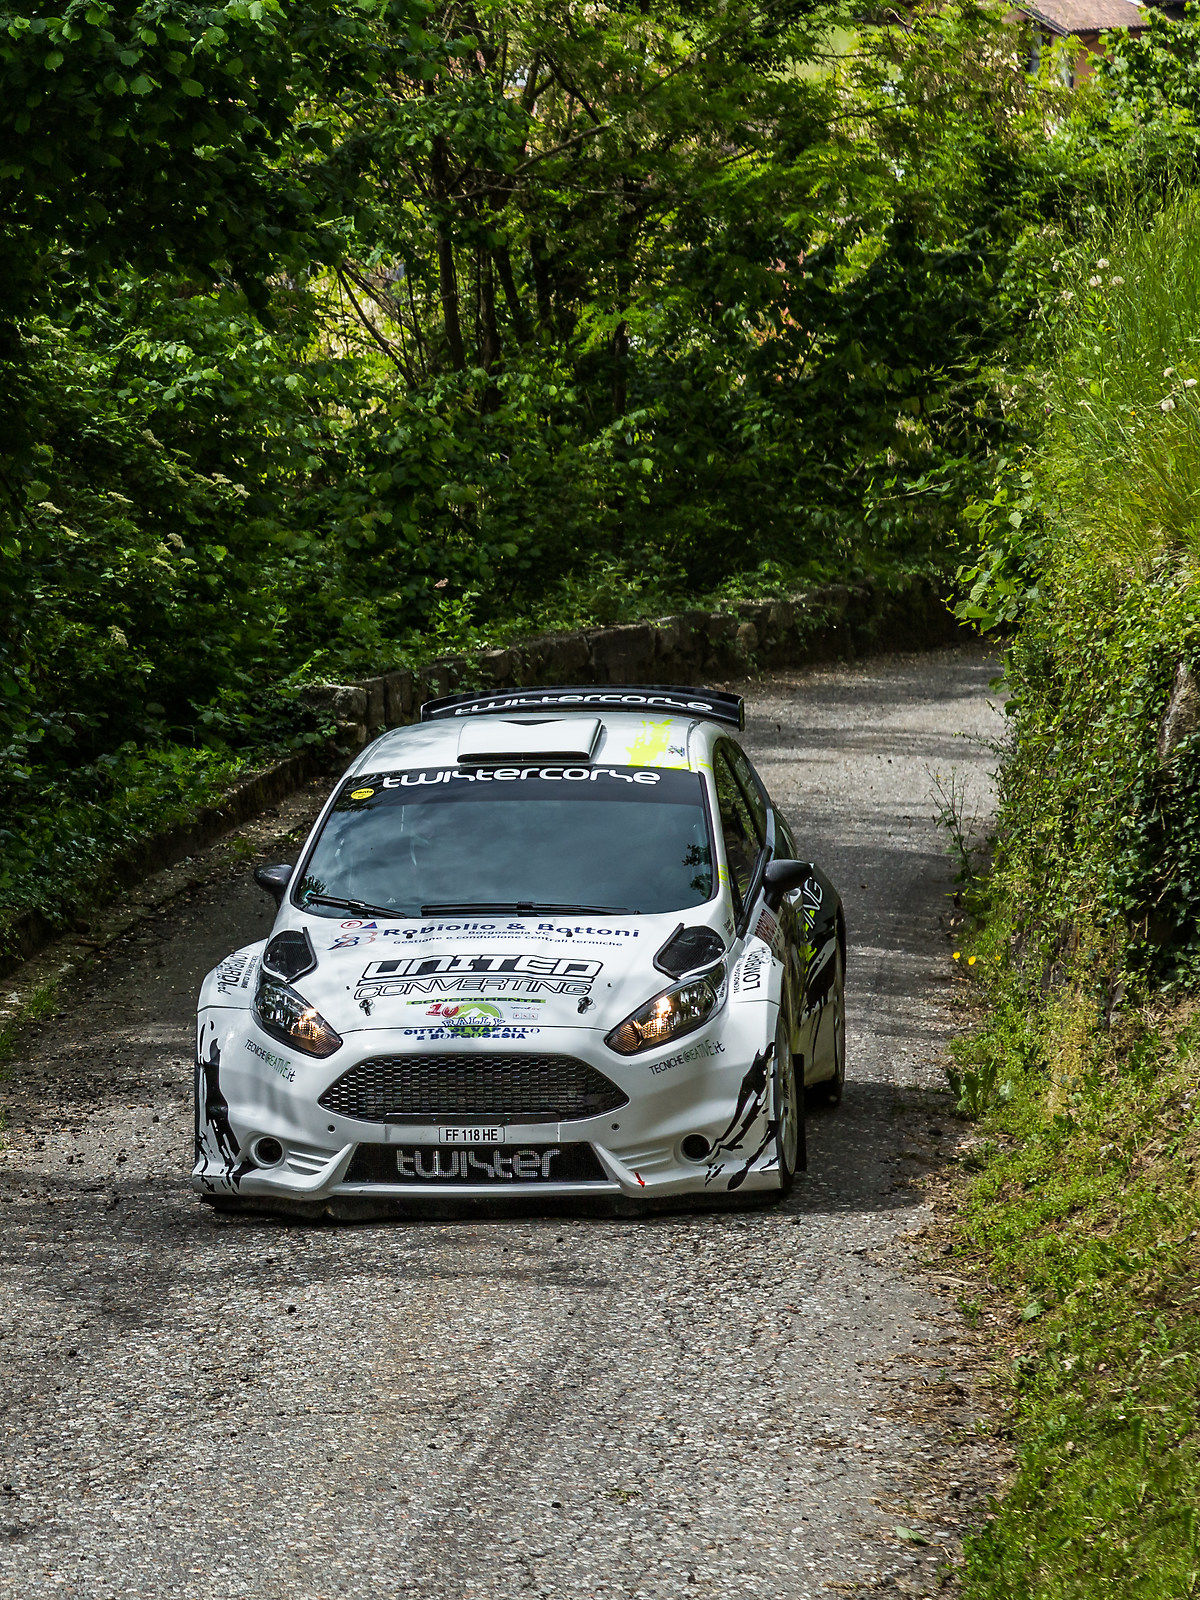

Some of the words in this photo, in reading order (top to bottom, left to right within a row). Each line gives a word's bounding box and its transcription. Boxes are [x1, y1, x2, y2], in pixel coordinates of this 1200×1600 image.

[454, 694, 713, 715] twistercorse
[382, 767, 661, 788] twistercorse
[383, 923, 496, 936] Robiolio
[506, 922, 525, 930] &
[361, 954, 604, 980] UNITED
[354, 977, 594, 1000] CONVERTING
[410, 997, 542, 1005] CONCORRENTE
[442, 1016, 506, 1027] RALLY
[445, 1129, 459, 1141] FF
[462, 1129, 480, 1141] 118
[482, 1129, 498, 1141] HE
[396, 1150, 561, 1178] twister
